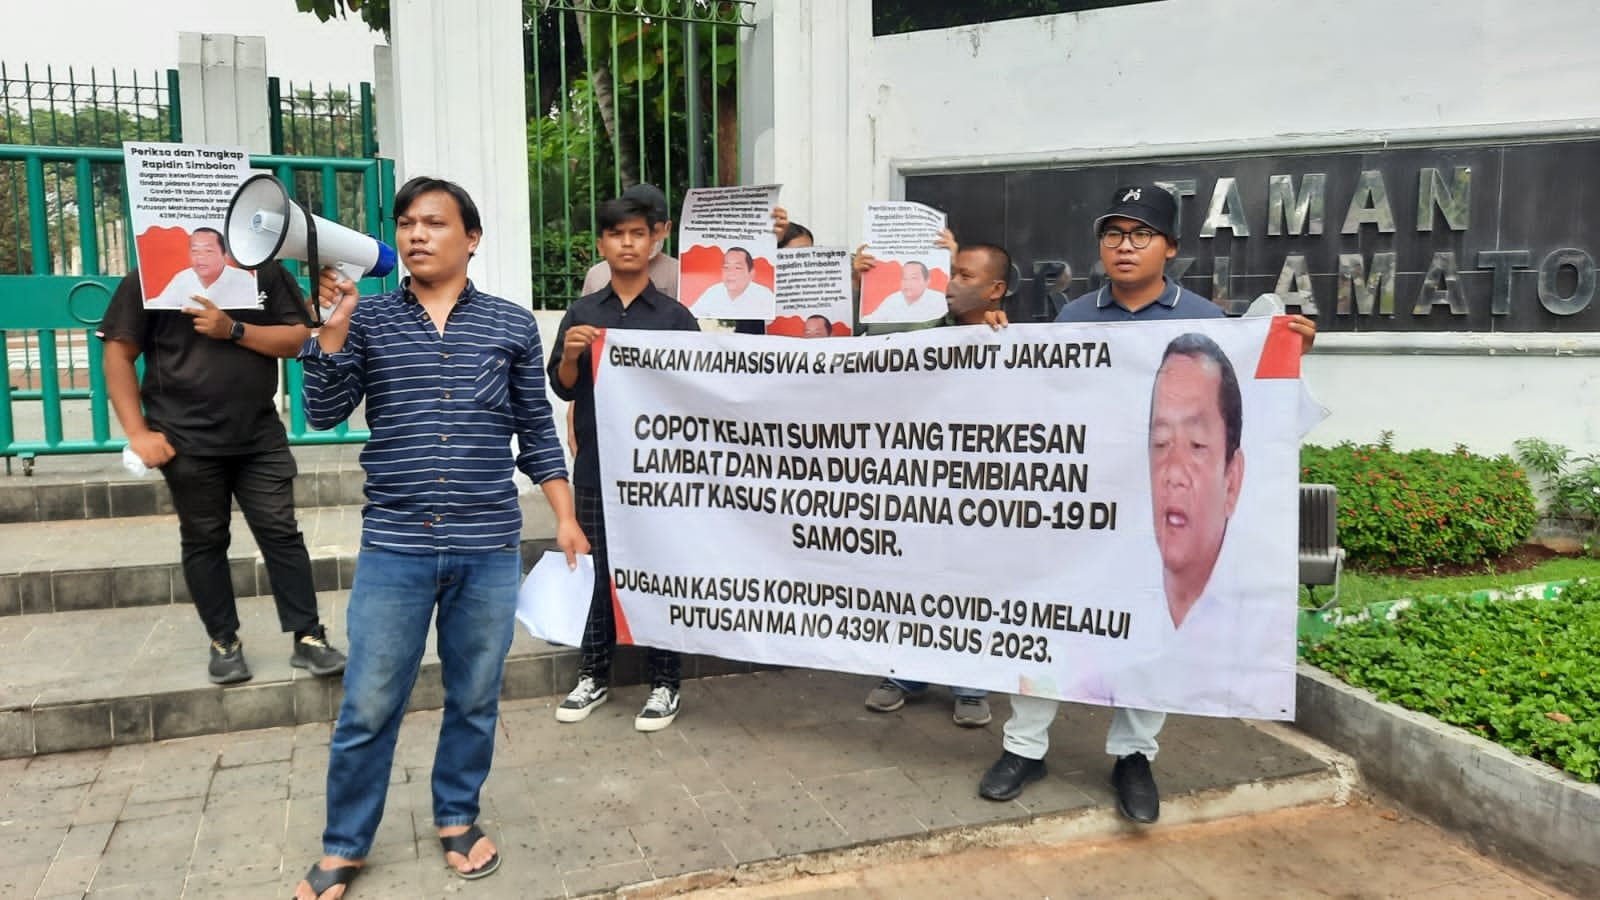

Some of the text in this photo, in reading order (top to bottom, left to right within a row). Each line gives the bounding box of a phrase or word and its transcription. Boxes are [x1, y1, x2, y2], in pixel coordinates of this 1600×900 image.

[131, 147, 244, 160] Periksa dan Tangkap
[142, 160, 236, 170] Rapidin Simbolon
[609, 342, 1112, 374] GERAKAN MAHASISWA & PEMUDA SUMUT JAKARTA
[635, 414, 1087, 454] COPOT KEJATI SUMUT YANG TERKESAN
[633, 448, 1088, 493] LAMBAT DAN ADA DUGAAN PEMBIARAN
[617, 480, 1117, 530] TERKAIT KASUS KORUPSI DANA COVID-19 DI
[792, 523, 903, 557] SAMOSIR.
[614, 568, 1131, 640] DUGAAN KASUS KORUPSI DANA COVID-19 MELALUI
[670, 605, 763, 633] PUTUSAN
[766, 609, 796, 636] MA
[801, 613, 833, 639] NO
